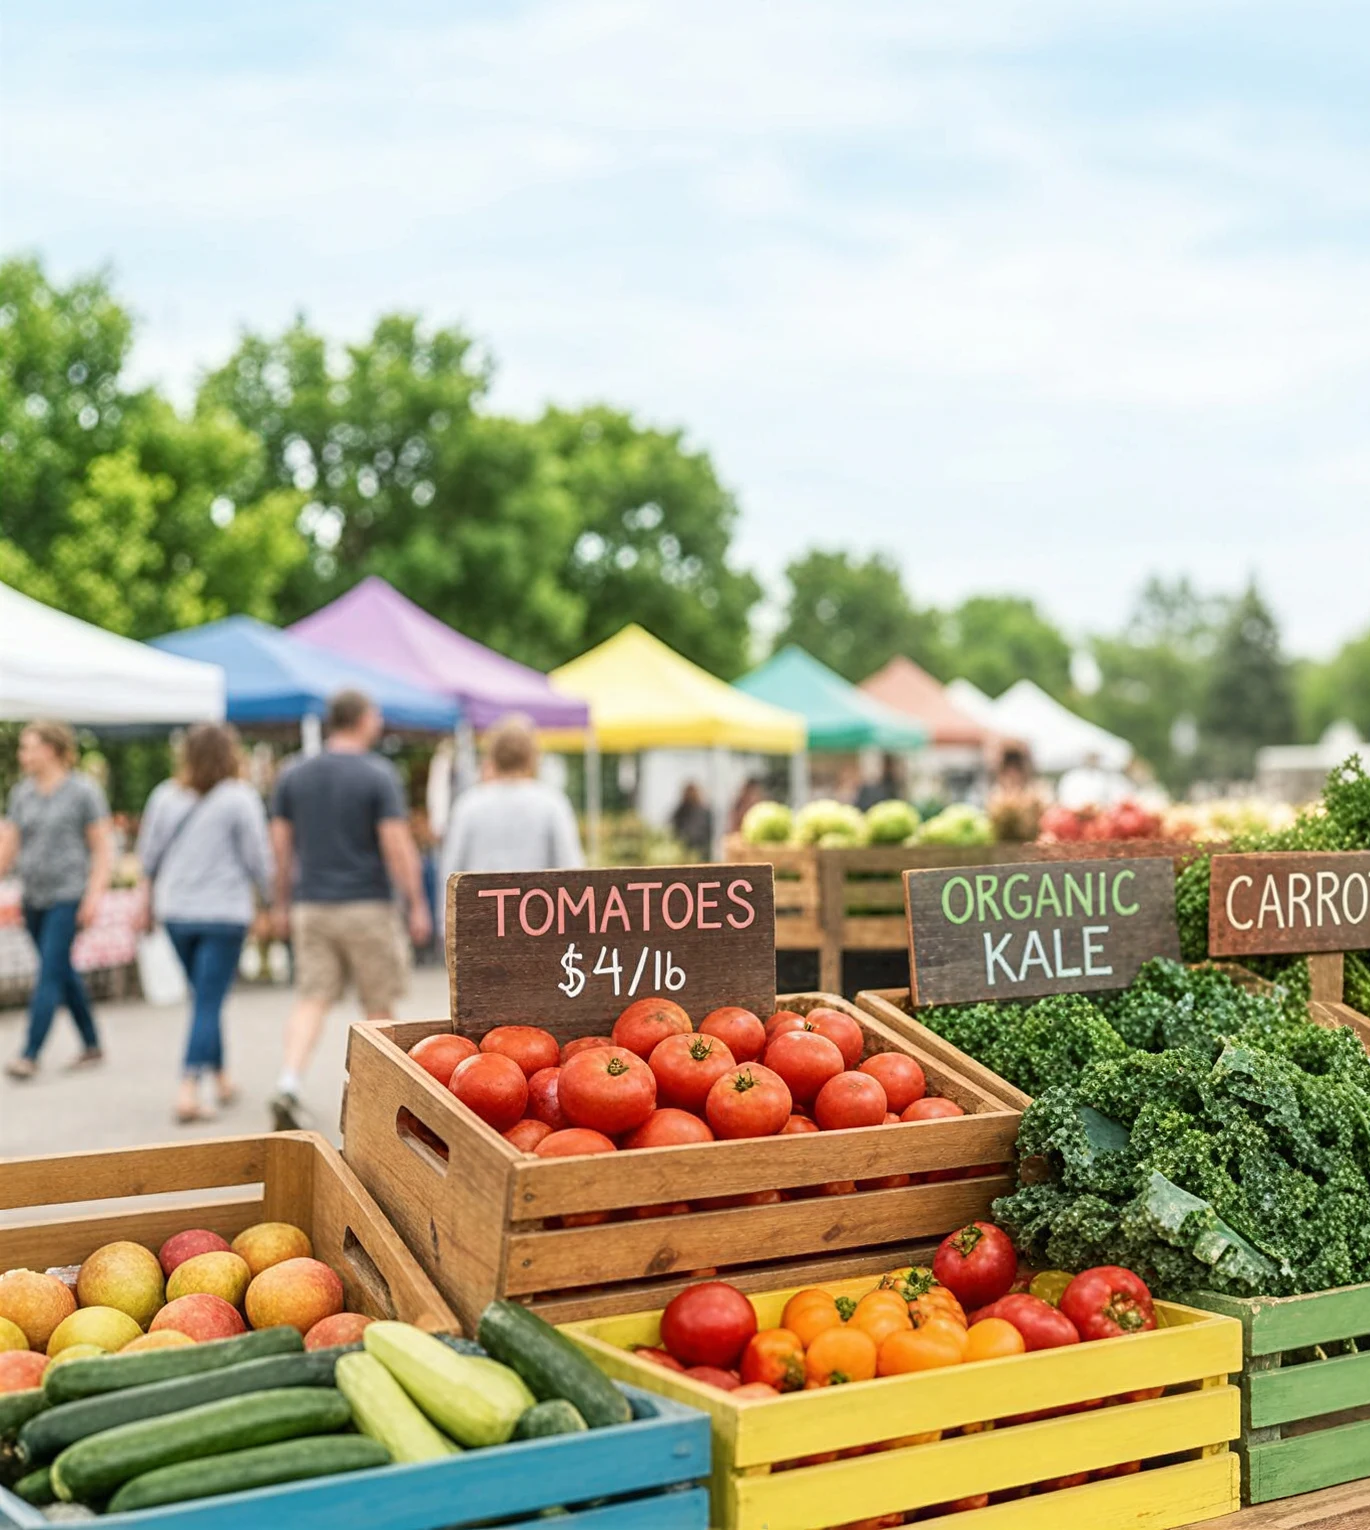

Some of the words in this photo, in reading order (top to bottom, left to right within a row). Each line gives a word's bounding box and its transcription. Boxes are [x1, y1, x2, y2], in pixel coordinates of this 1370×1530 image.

[478, 879, 756, 937] TOMATOES
[941, 868, 1141, 925] ORGANIC
[558, 943, 686, 998] $4/lb
[983, 925, 1113, 986] KALE
